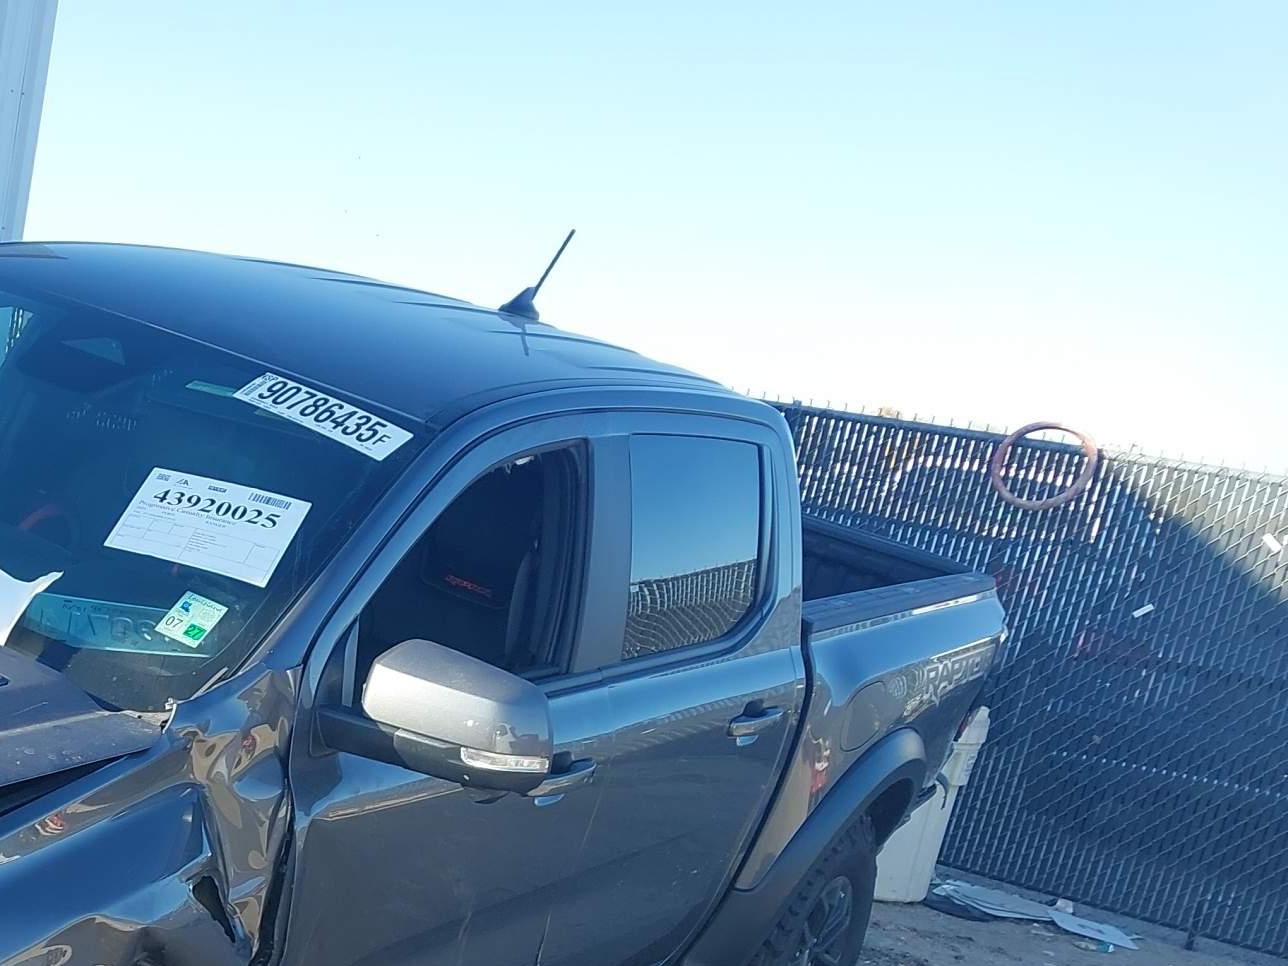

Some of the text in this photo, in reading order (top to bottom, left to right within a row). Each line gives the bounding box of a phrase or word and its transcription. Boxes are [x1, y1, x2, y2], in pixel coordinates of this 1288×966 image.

[258, 380, 387, 443] 90786435
[372, 434, 392, 445] F
[154, 488, 281, 529] 43920025
[165, 615, 204, 639] 07 27
